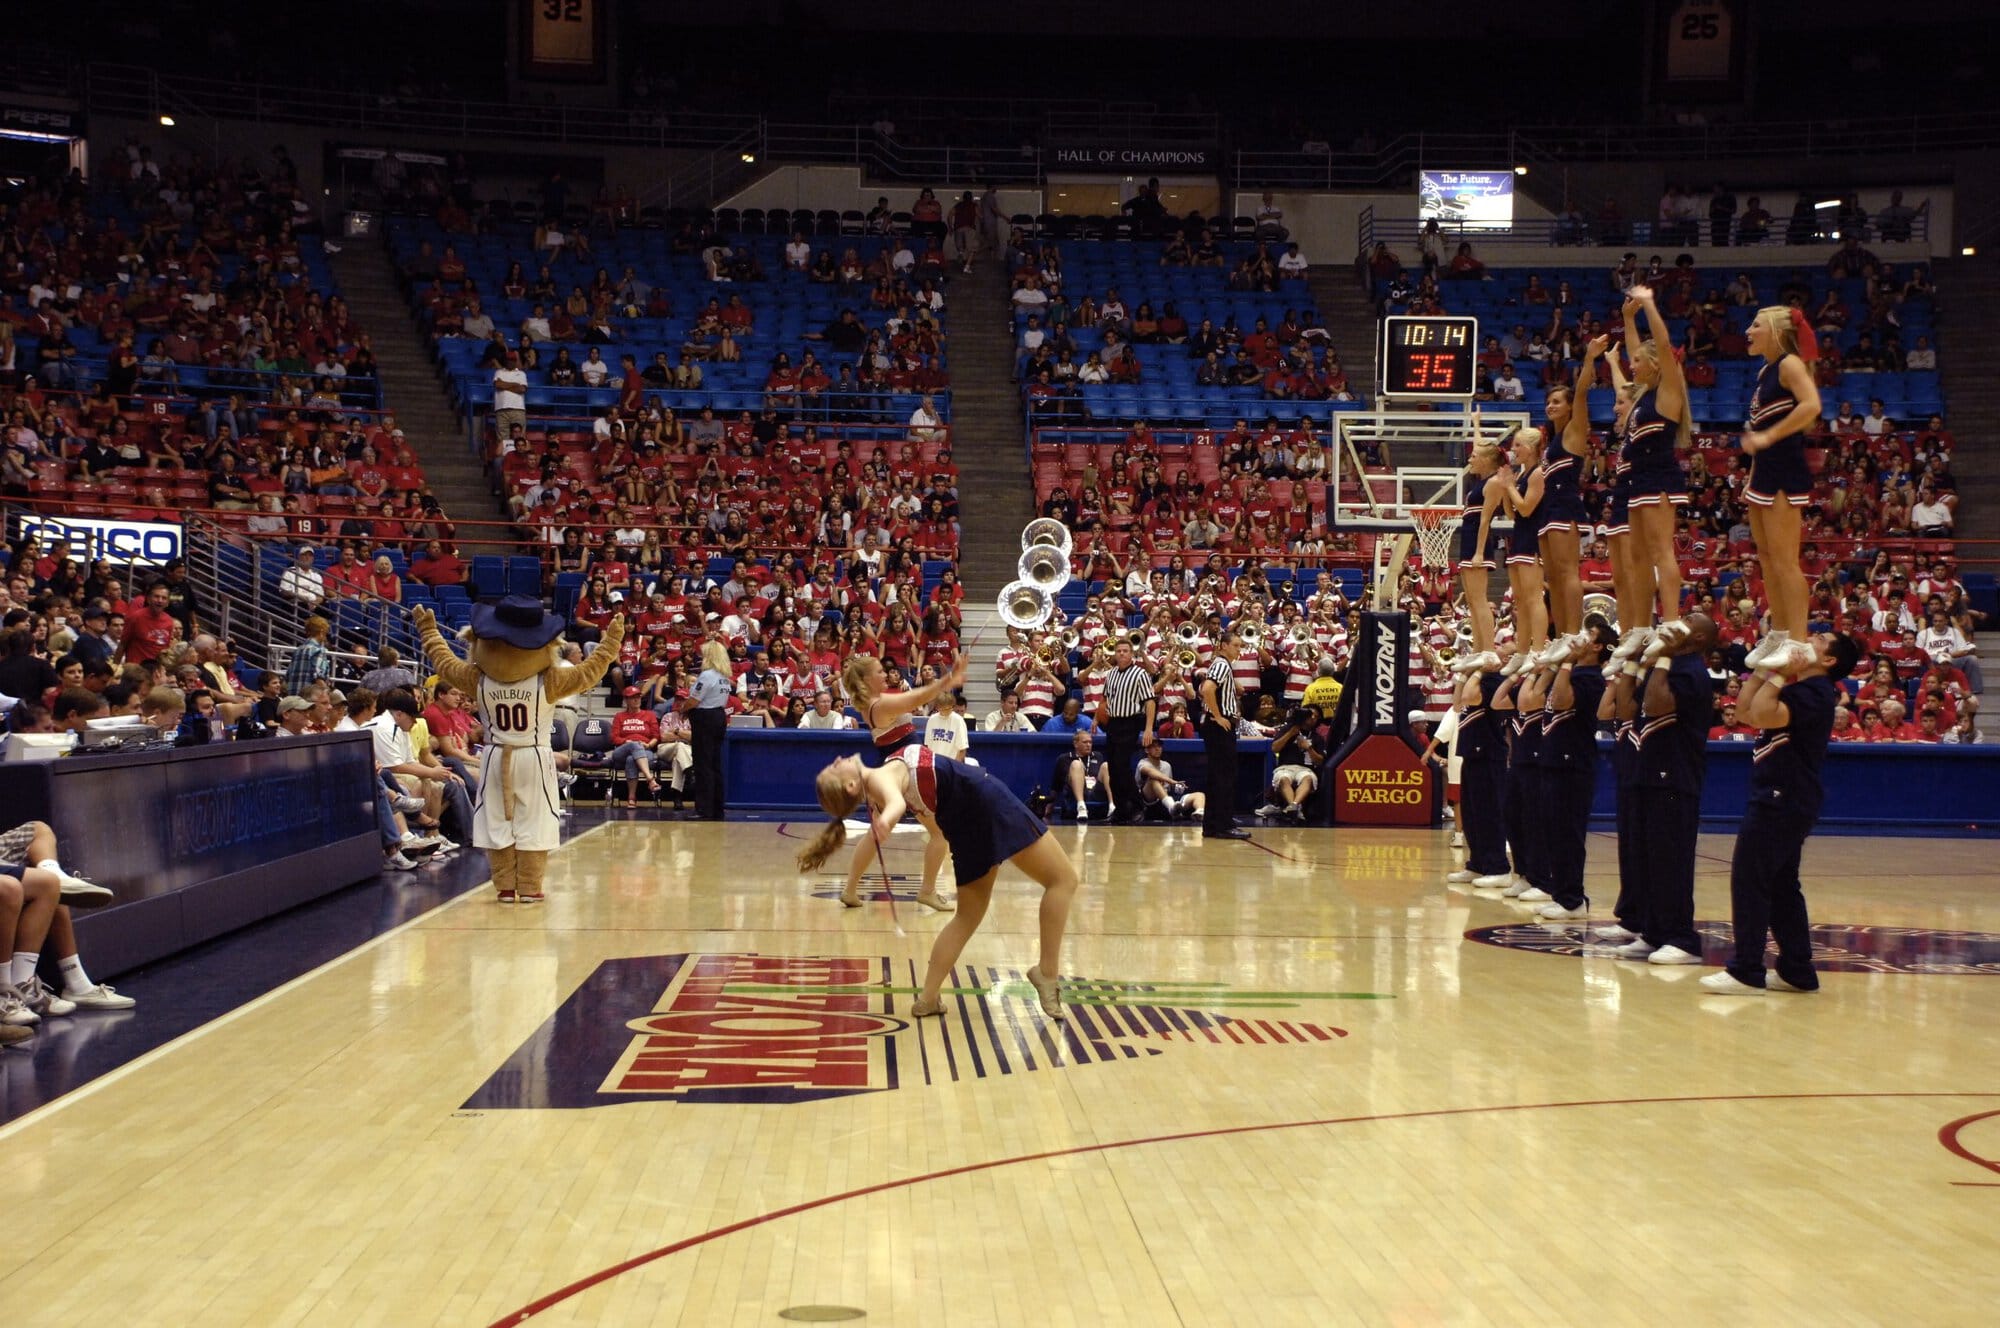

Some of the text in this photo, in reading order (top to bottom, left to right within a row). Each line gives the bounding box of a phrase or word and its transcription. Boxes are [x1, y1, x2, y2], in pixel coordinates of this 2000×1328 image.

[543, 0, 582, 22] 32
[1682, 13, 1719, 40] 25
[4, 109, 71, 128] PEPSI
[1058, 150, 1205, 164] HALL OF CHAMPIONS
[1441, 173, 1458, 184] The
[1404, 325, 1466, 346] 10:14
[1406, 355, 1455, 387] 35
[153, 402, 166, 415] 19
[1197, 435, 1211, 445] 21
[1698, 438, 1713, 449] 22
[298, 519, 312, 532] 19
[25, 523, 178, 560] GEICO
[1376, 621, 1395, 725] ARIZONA
[489, 688, 532, 702] WILBUR
[496, 703, 528, 732] 00
[1344, 769, 1424, 785] WELLS
[1346, 788, 1422, 805] FARGO
[616, 955, 887, 1091] ARIZONA
